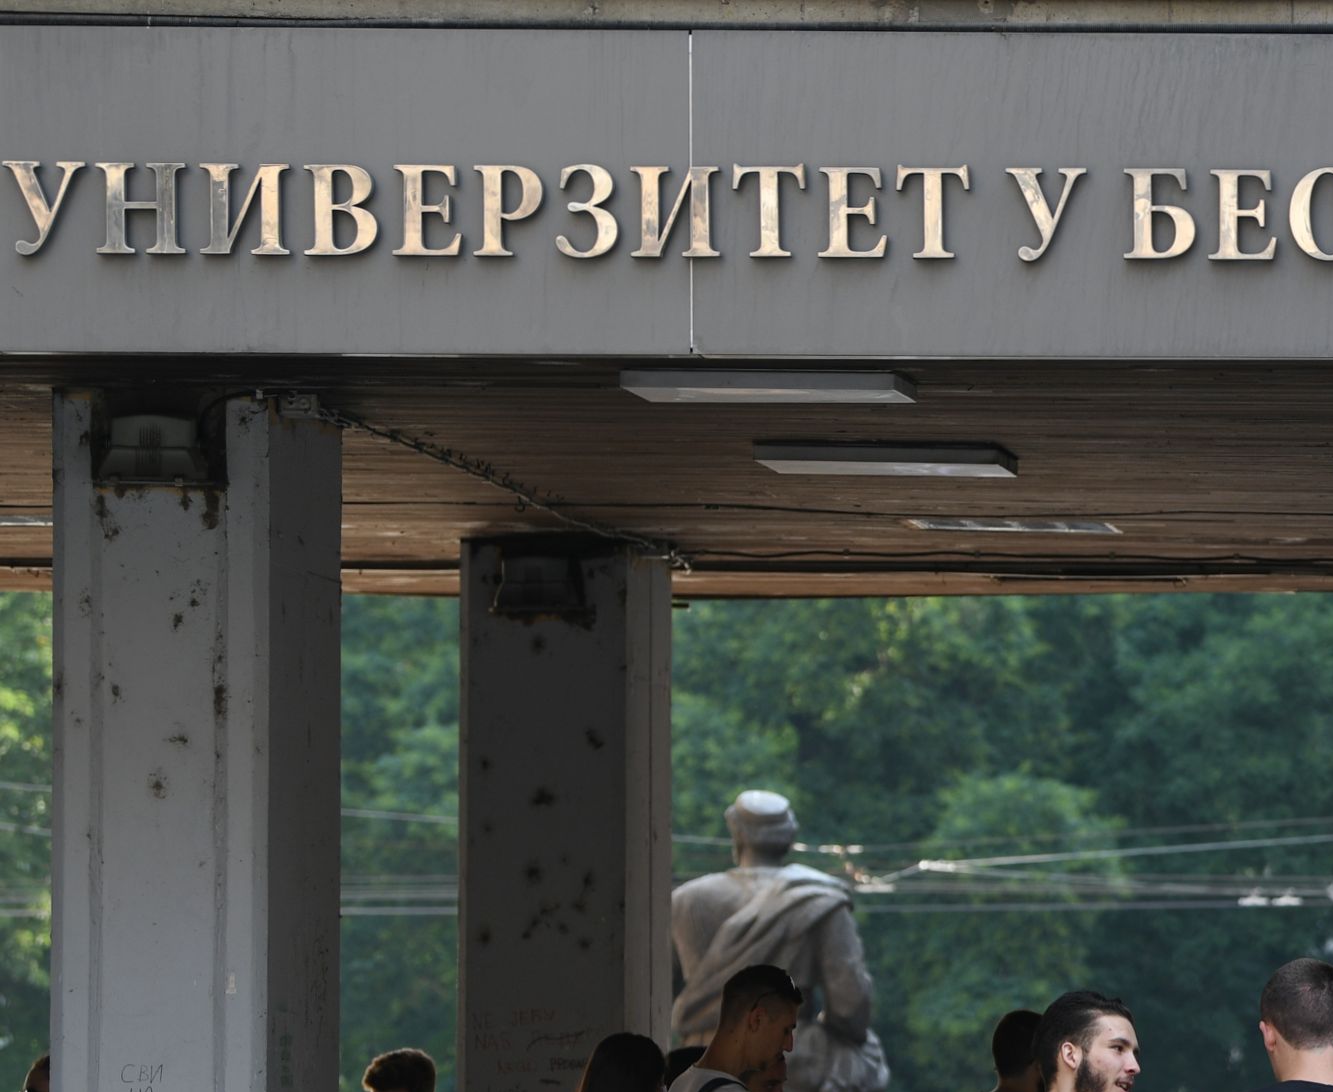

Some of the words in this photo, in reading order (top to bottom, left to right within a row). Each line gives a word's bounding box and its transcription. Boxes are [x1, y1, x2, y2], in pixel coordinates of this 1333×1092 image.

[2, 160, 971, 260] УНИВЕРЗИТЕТ
[1004, 166, 1088, 263] У
[120, 1063, 164, 1084] СВИ
